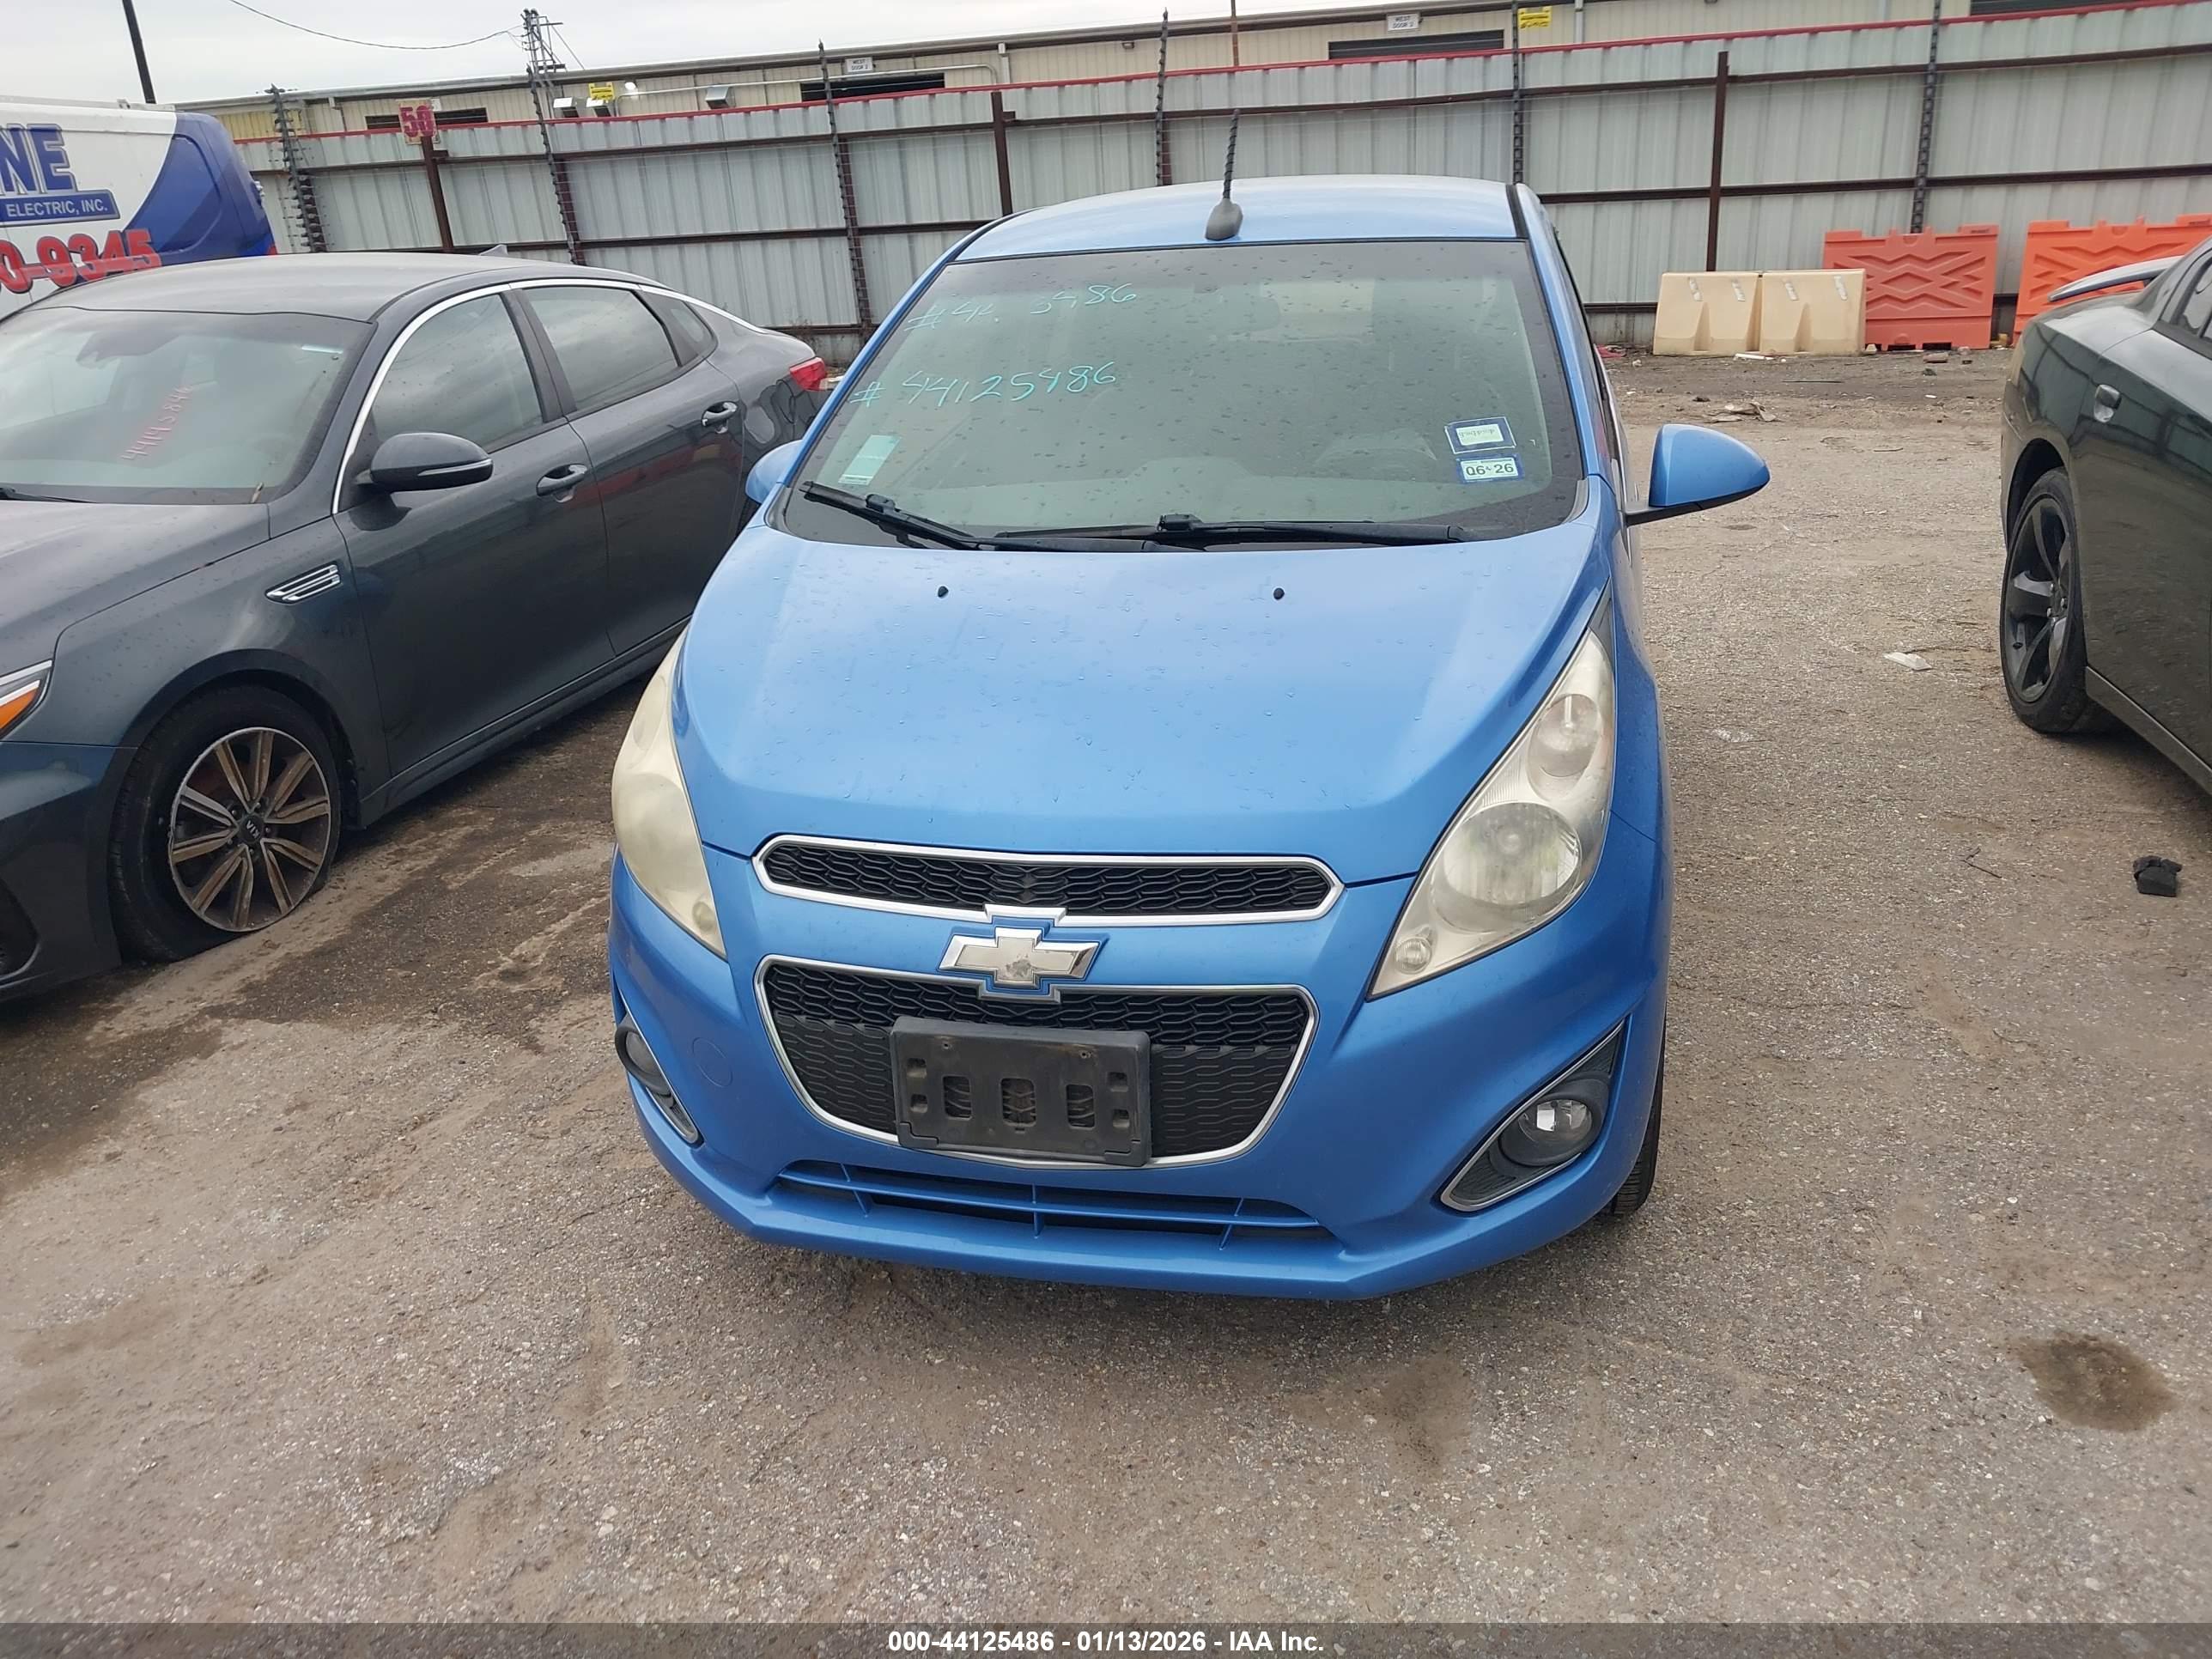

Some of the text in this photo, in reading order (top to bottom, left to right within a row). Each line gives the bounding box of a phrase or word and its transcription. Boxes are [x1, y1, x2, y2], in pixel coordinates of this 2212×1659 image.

[5, 198, 108, 217] ELECTRIC, INC.
[246, 820, 261, 839] KIA
